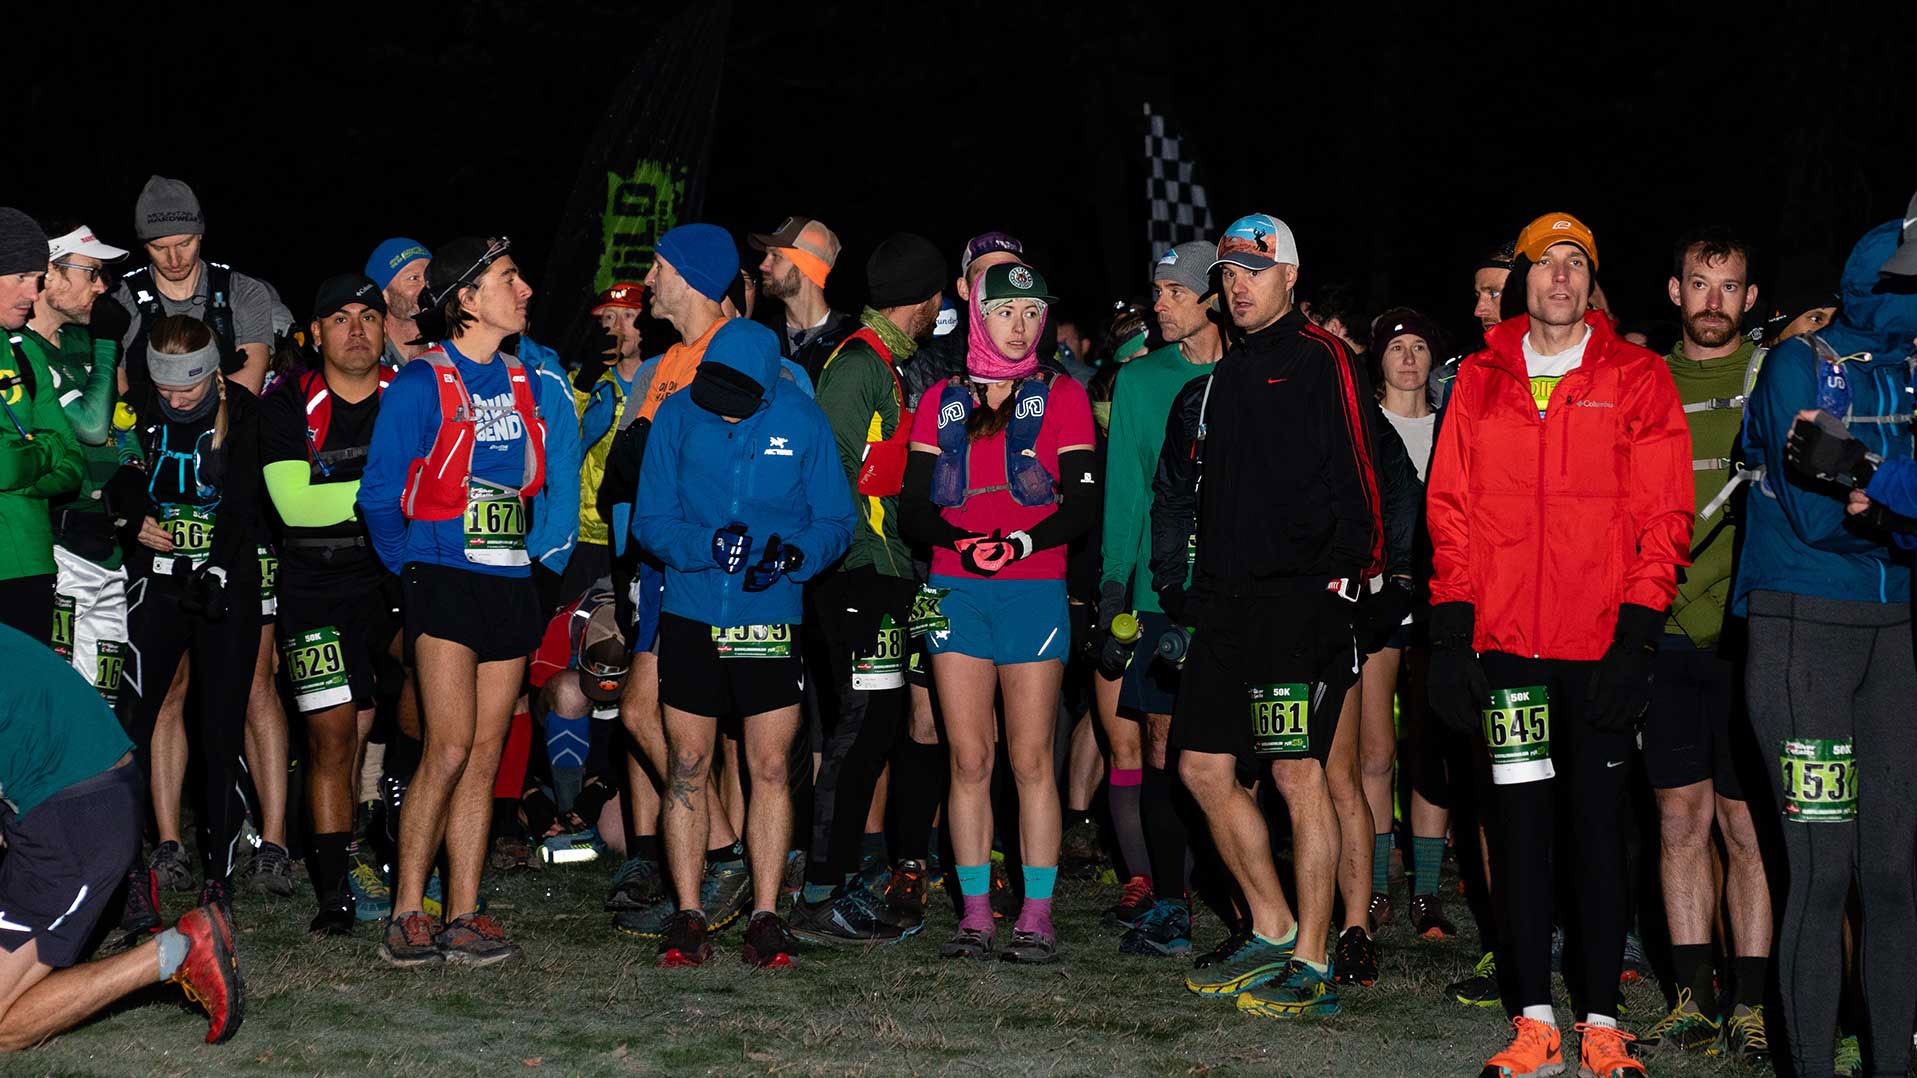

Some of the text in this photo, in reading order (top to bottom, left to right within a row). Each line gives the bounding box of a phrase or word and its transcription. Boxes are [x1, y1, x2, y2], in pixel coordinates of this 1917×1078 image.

[468, 502, 525, 534] 1670
[304, 631, 322, 643] 50K
[1272, 687, 1292, 697] 50K
[1510, 691, 1531, 703] 50K
